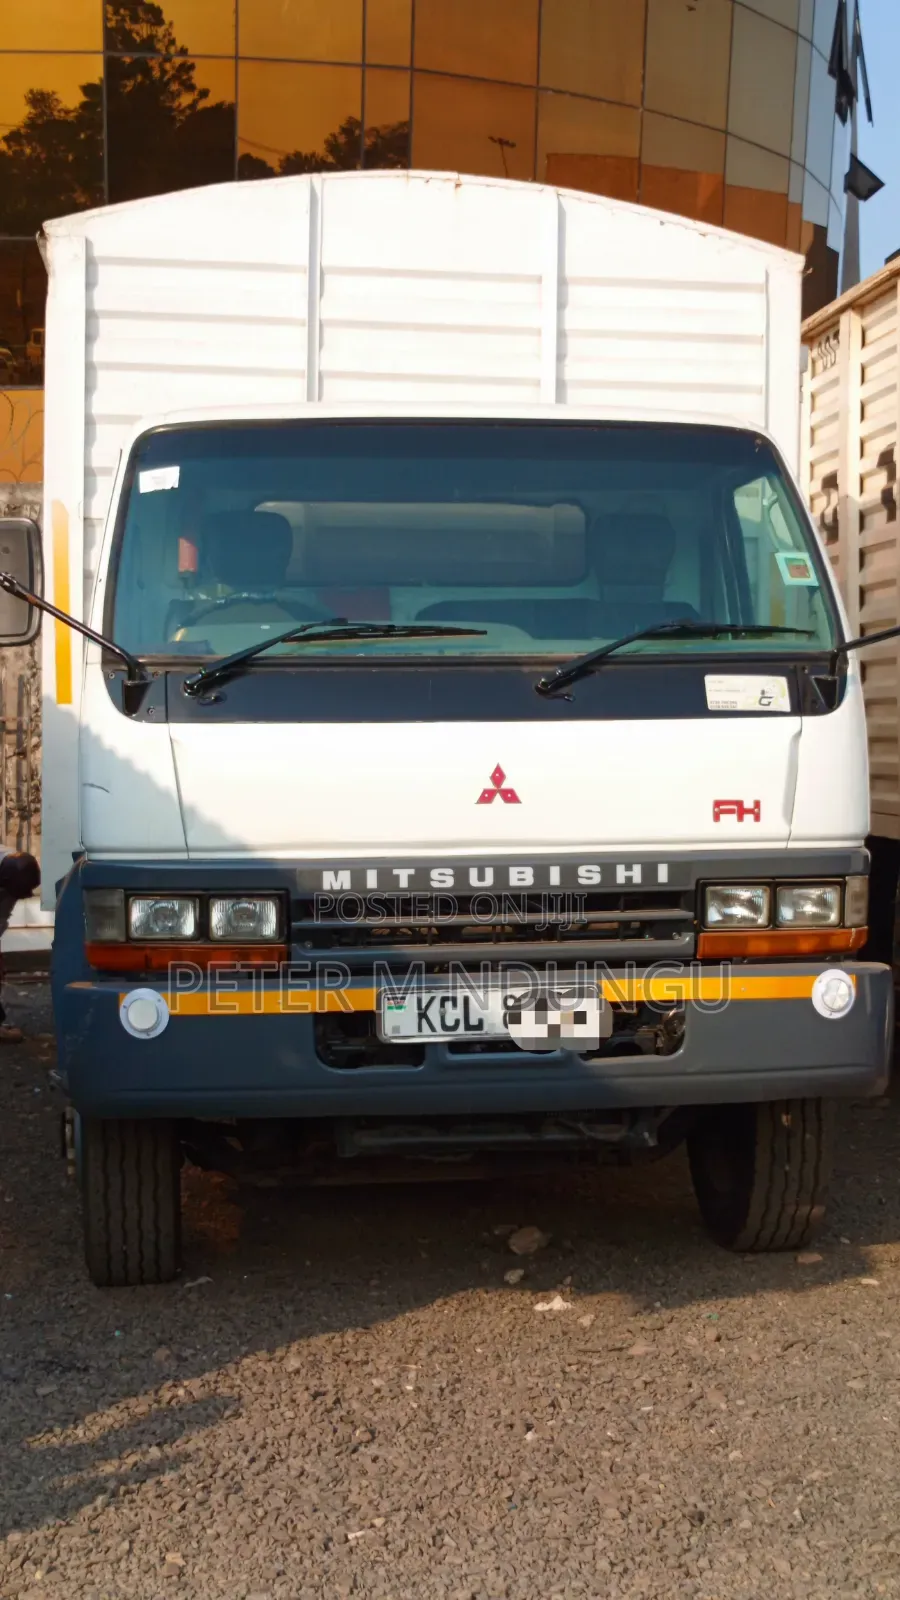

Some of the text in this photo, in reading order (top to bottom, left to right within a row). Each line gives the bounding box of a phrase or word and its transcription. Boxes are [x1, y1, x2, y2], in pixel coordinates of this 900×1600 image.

[713, 800, 761, 822] FH
[322, 863, 669, 890] MITSUBISHI
[417, 995, 484, 1033] KCL
